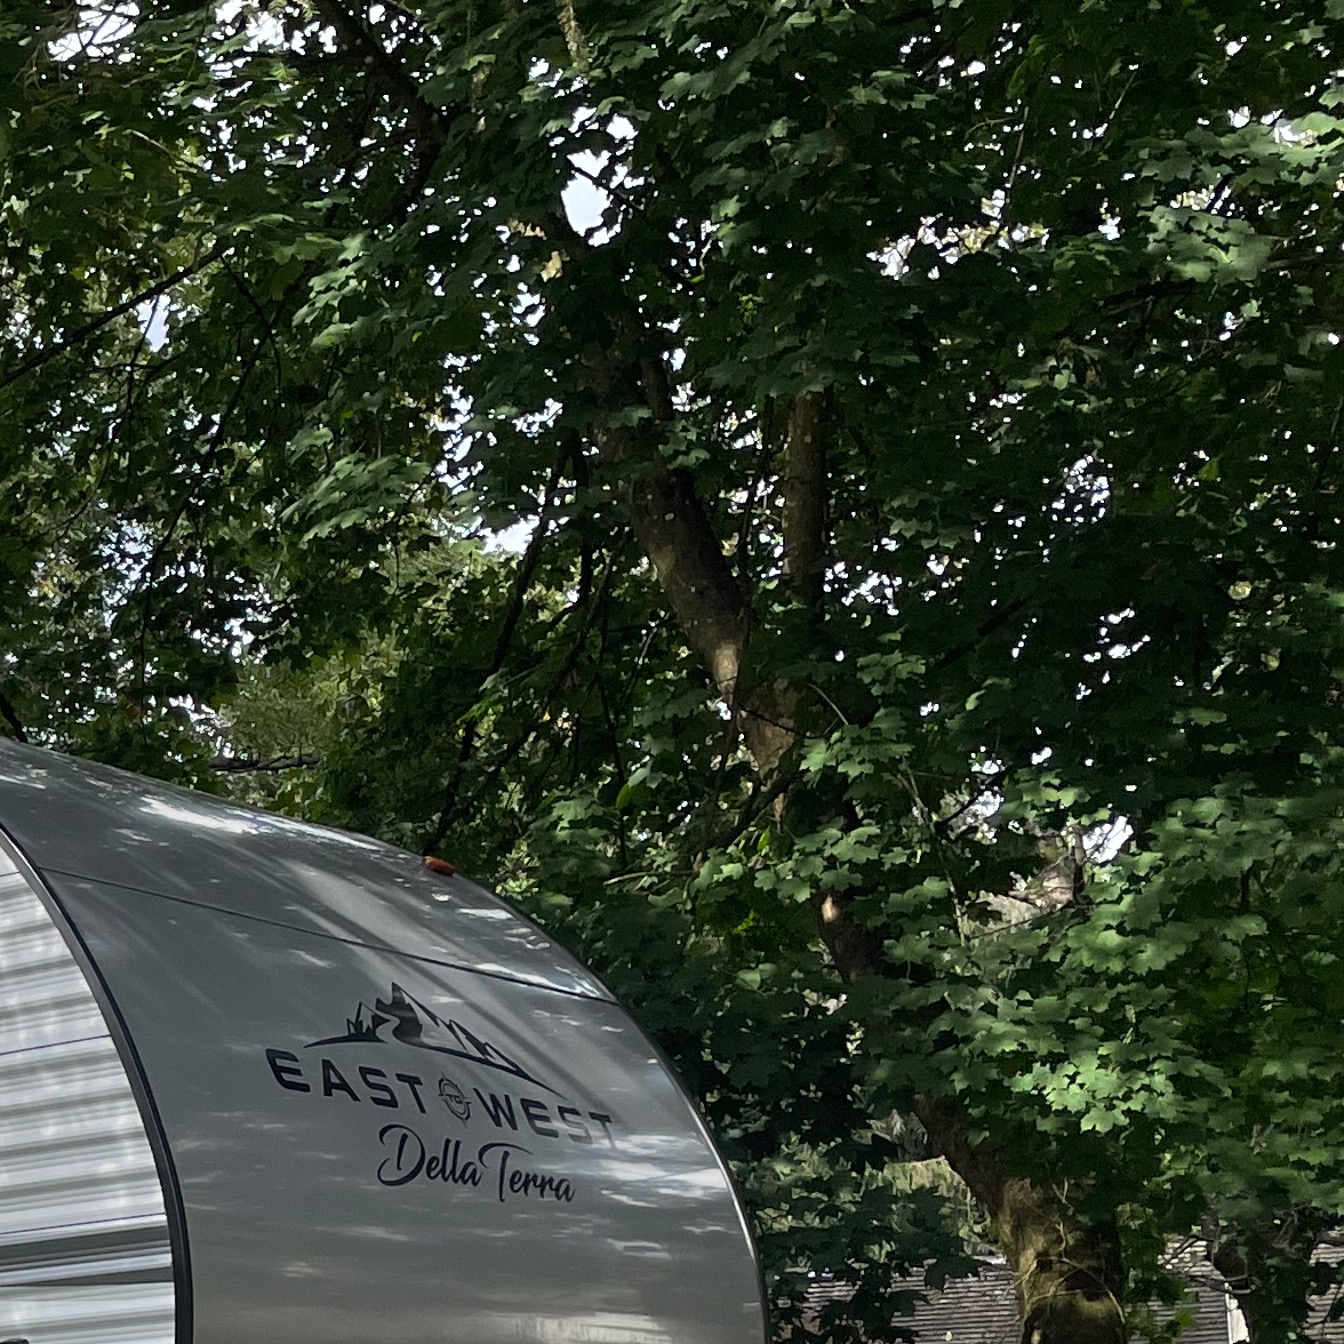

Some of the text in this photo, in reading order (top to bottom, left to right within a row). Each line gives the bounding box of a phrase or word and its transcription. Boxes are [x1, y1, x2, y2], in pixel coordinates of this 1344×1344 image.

[265, 1047, 427, 1114] EAST
[472, 1087, 616, 1149] WEST
[376, 1123, 576, 1203] Della Terra
